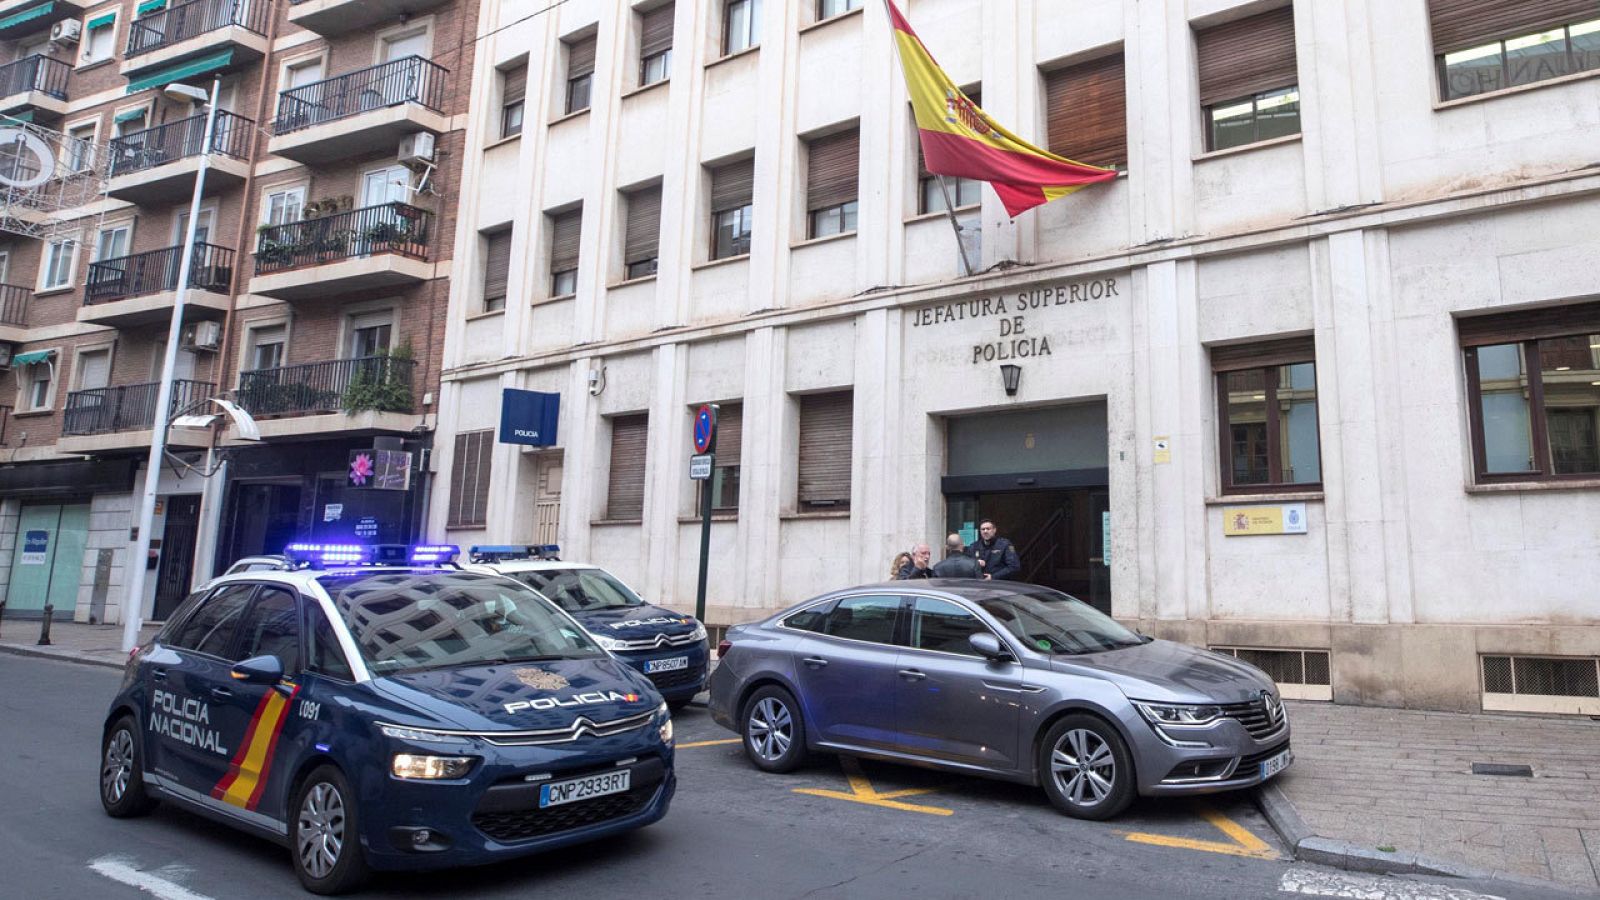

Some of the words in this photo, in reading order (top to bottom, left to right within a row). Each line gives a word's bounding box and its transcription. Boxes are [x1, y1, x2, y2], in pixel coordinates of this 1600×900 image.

[913, 296, 1007, 327] JEFATURA
[1016, 278, 1119, 311] SUPERIOR
[999, 316, 1025, 337] DE
[972, 336, 1051, 364] POLICIA
[149, 713, 228, 756] NACIONAL
